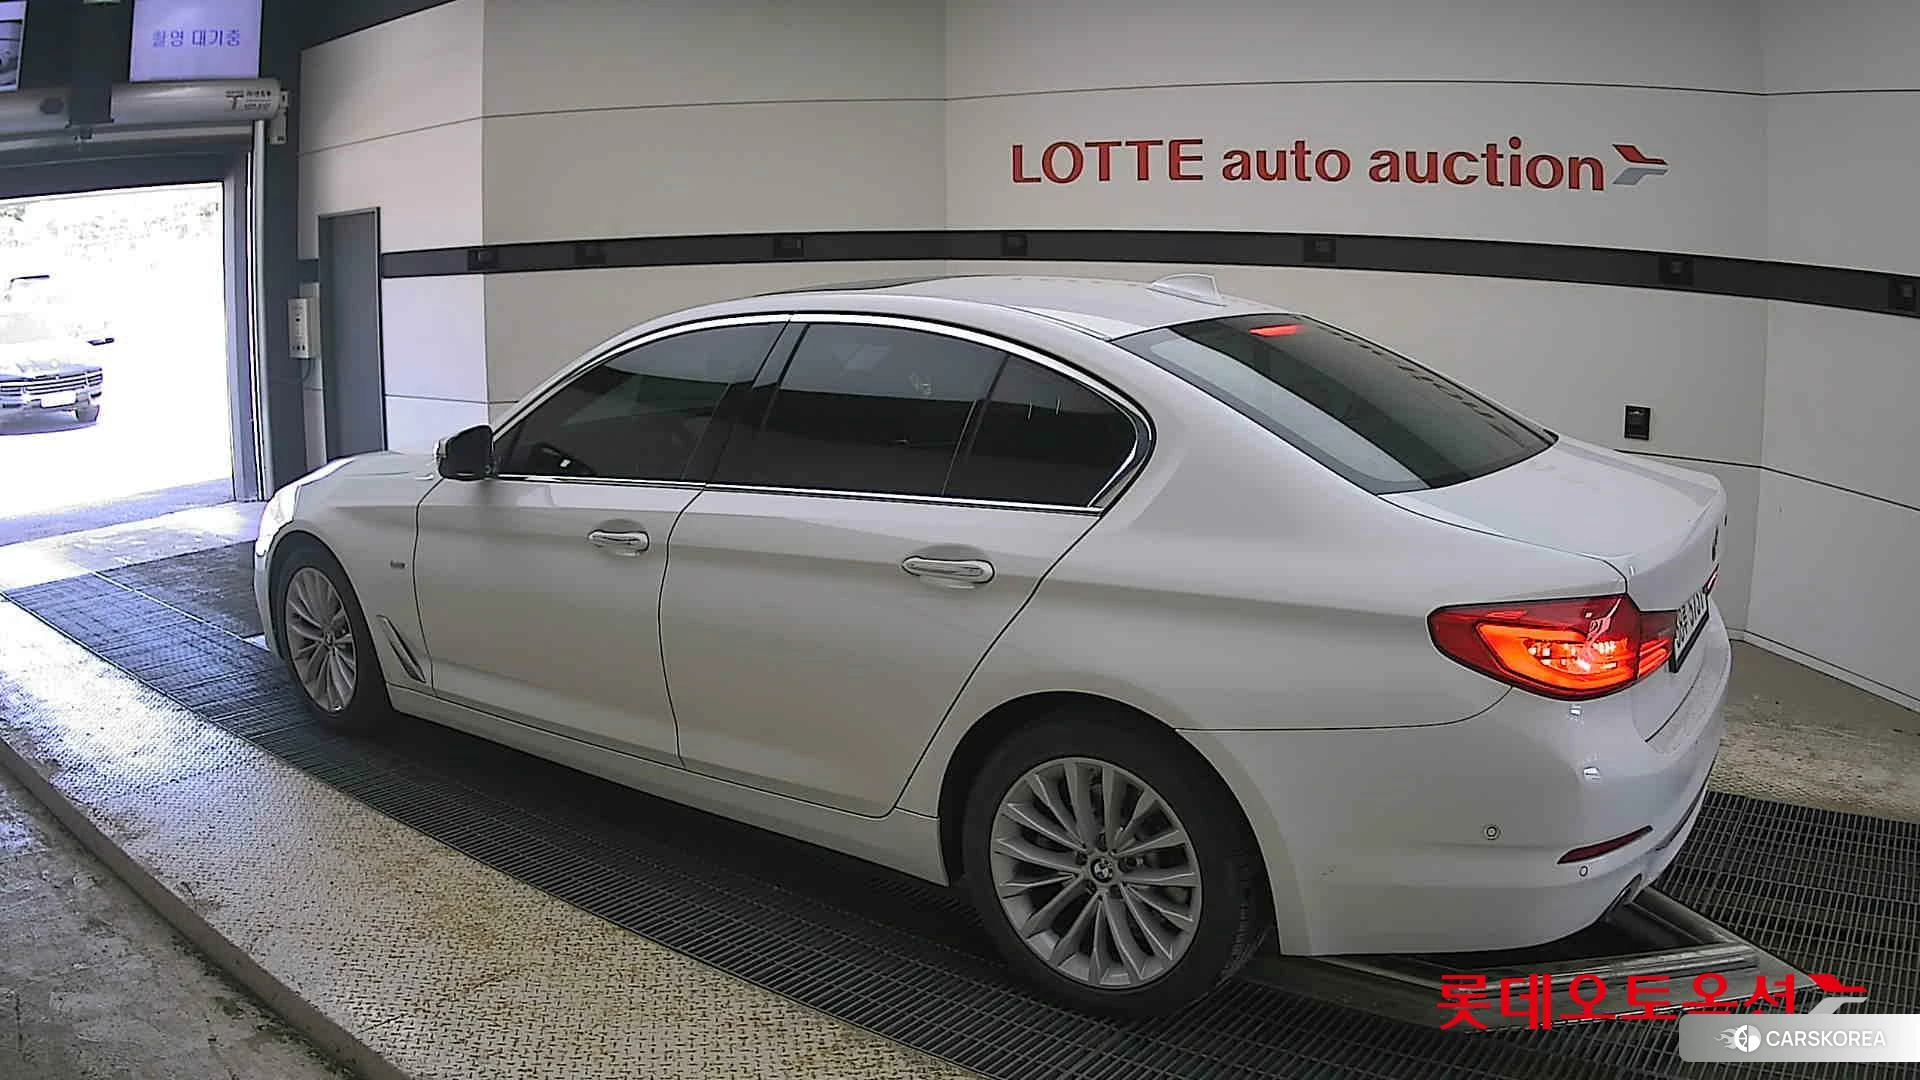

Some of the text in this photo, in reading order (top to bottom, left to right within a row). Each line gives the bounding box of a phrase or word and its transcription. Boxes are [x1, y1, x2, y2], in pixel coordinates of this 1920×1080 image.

[192, 28, 241, 47] 대기중
[1011, 137, 1605, 191] LOTTE auto auction
